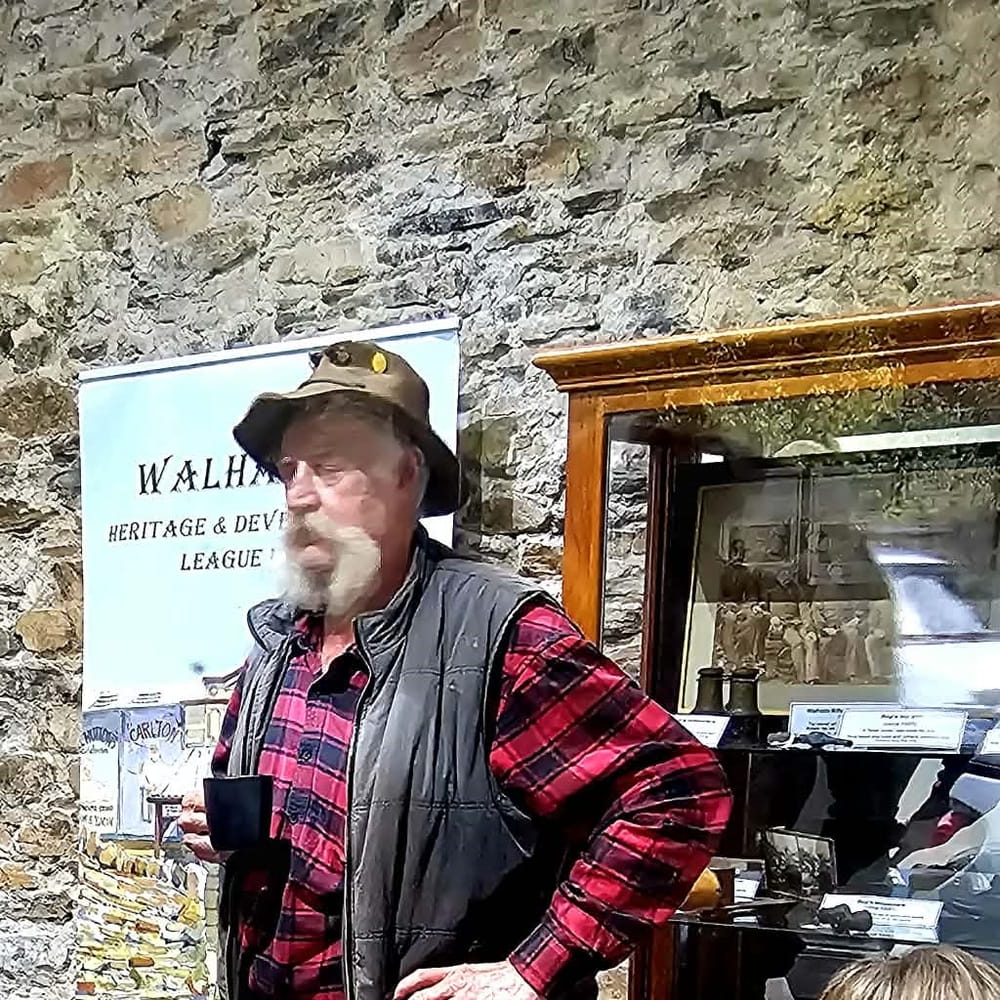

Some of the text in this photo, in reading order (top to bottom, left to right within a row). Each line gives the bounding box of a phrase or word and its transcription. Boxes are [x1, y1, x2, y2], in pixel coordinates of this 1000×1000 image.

[109, 517, 206, 543] HERITAGE
[213, 517, 227, 536] &
[180, 548, 262, 572] LEAGUE
